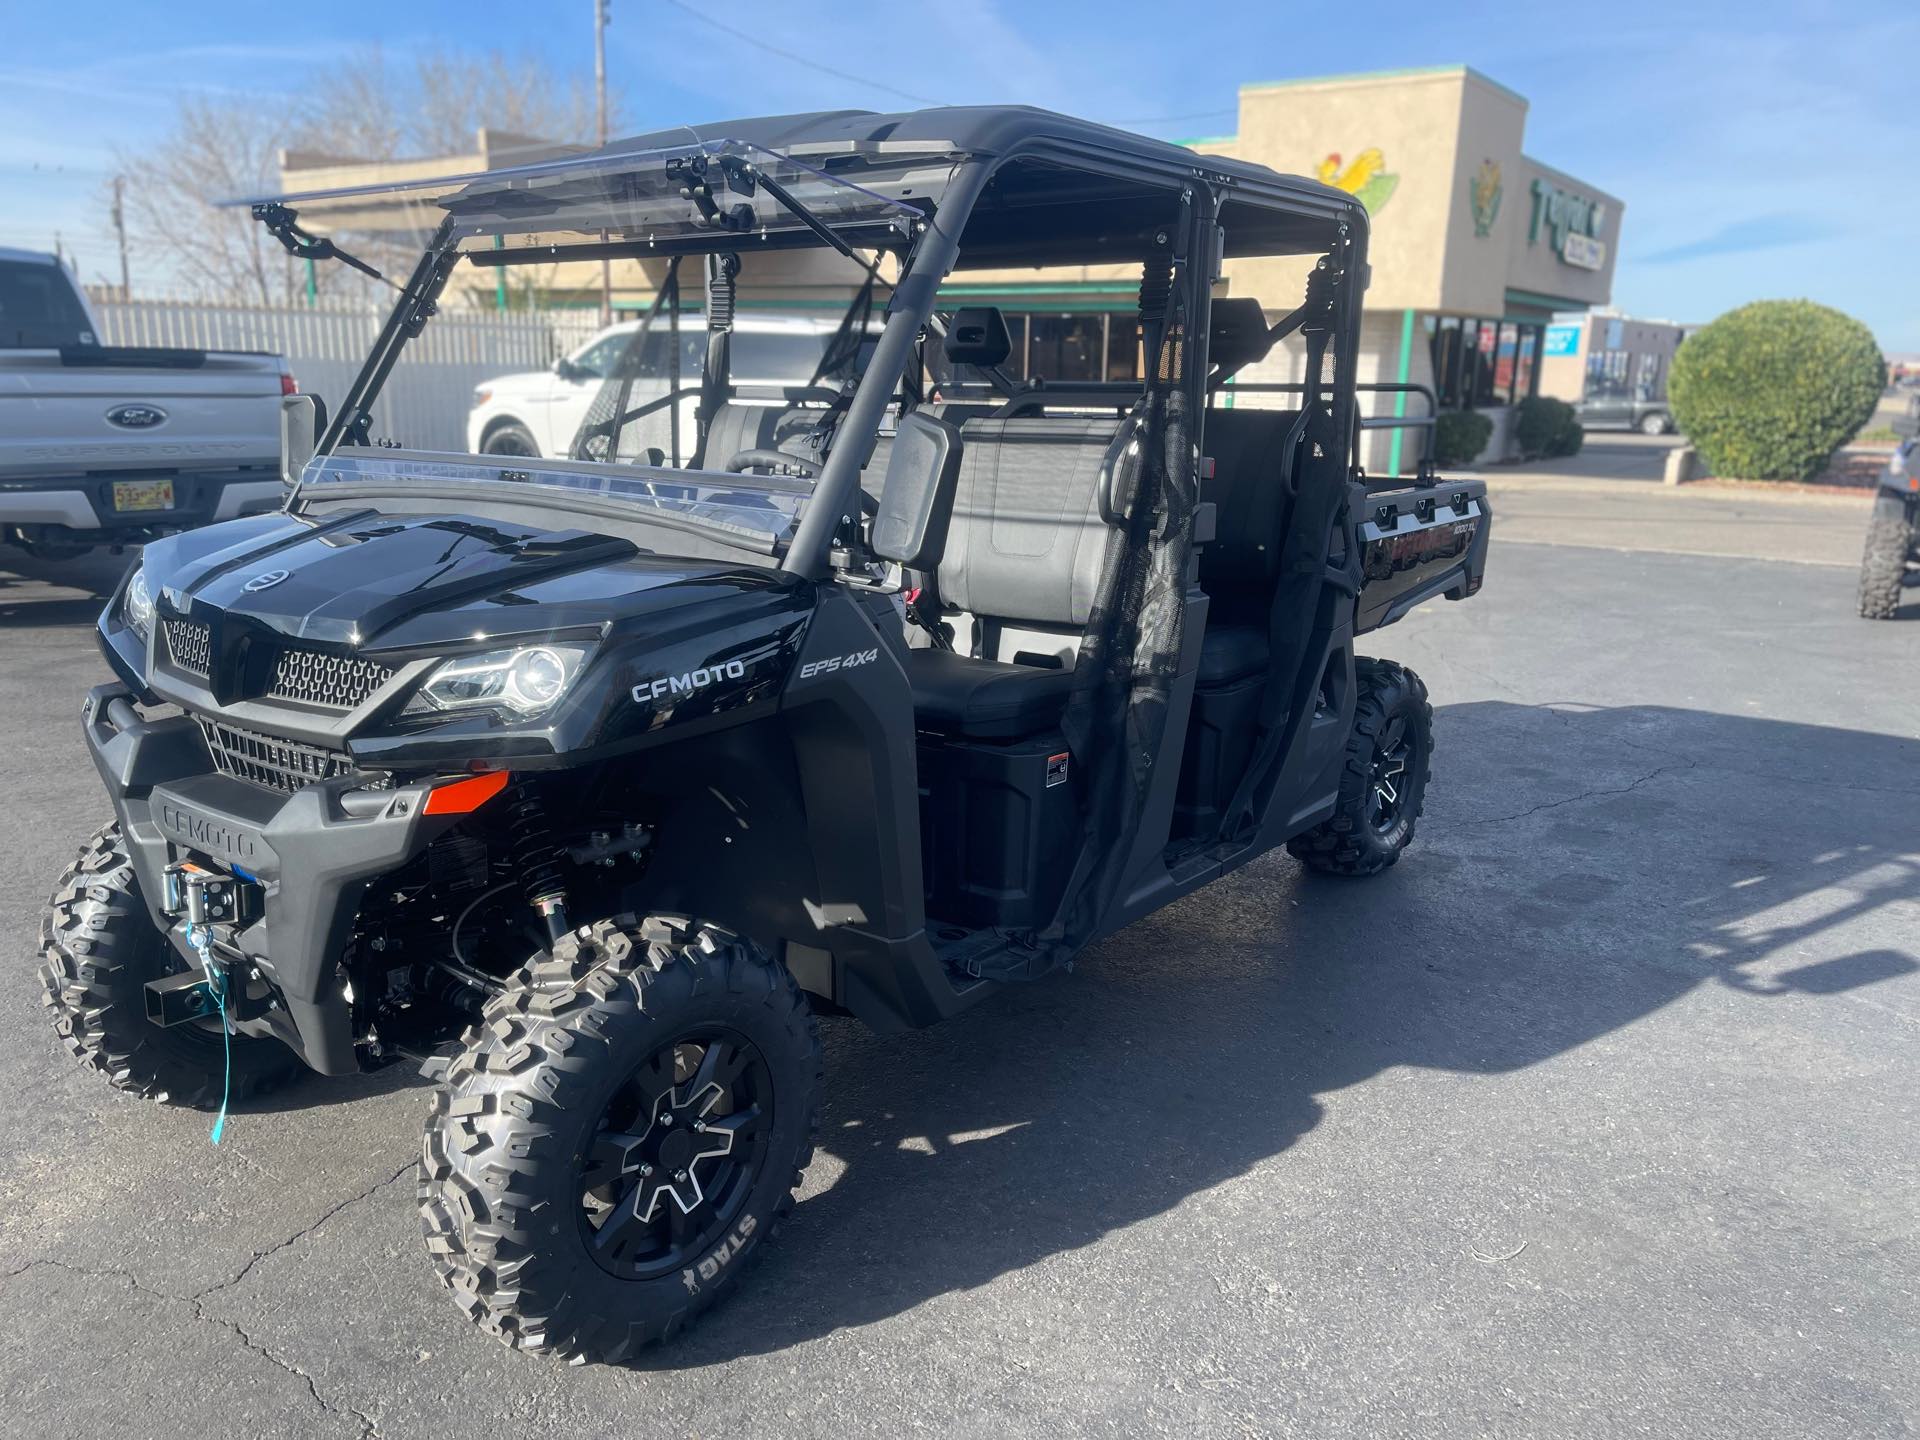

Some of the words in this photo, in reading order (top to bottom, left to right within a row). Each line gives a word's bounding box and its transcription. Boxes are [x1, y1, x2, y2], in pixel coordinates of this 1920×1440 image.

[631, 660, 745, 703] CFMOTO
[800, 656, 842, 679] EPS
[841, 648, 879, 669] 4X4
[163, 805, 255, 858] CFMOTO
[697, 1213, 758, 1281] STAG
